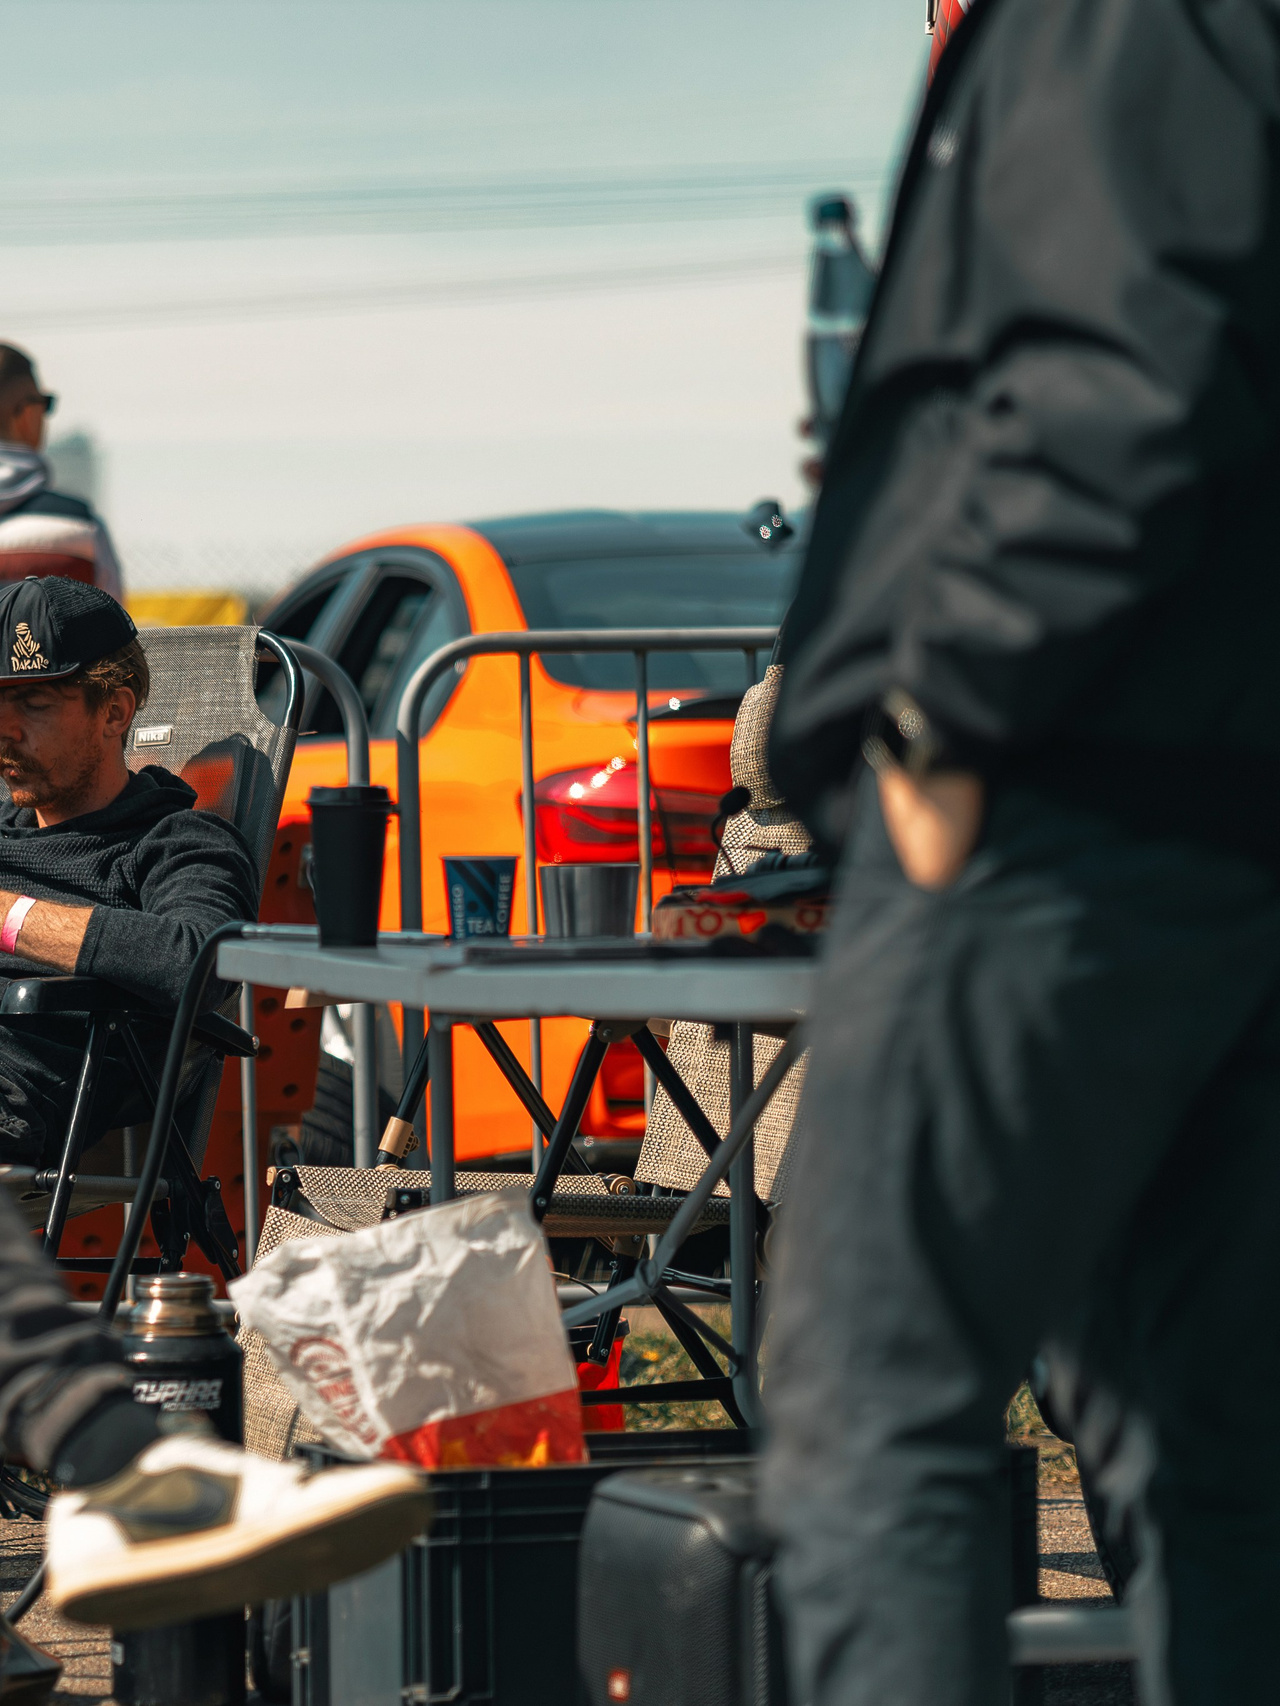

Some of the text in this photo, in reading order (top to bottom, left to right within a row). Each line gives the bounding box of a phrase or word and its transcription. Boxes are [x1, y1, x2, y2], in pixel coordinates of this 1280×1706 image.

[452, 884, 465, 939] SPRESSO
[467, 919, 494, 934] TEA
[496, 873, 511, 934] COFFEE
